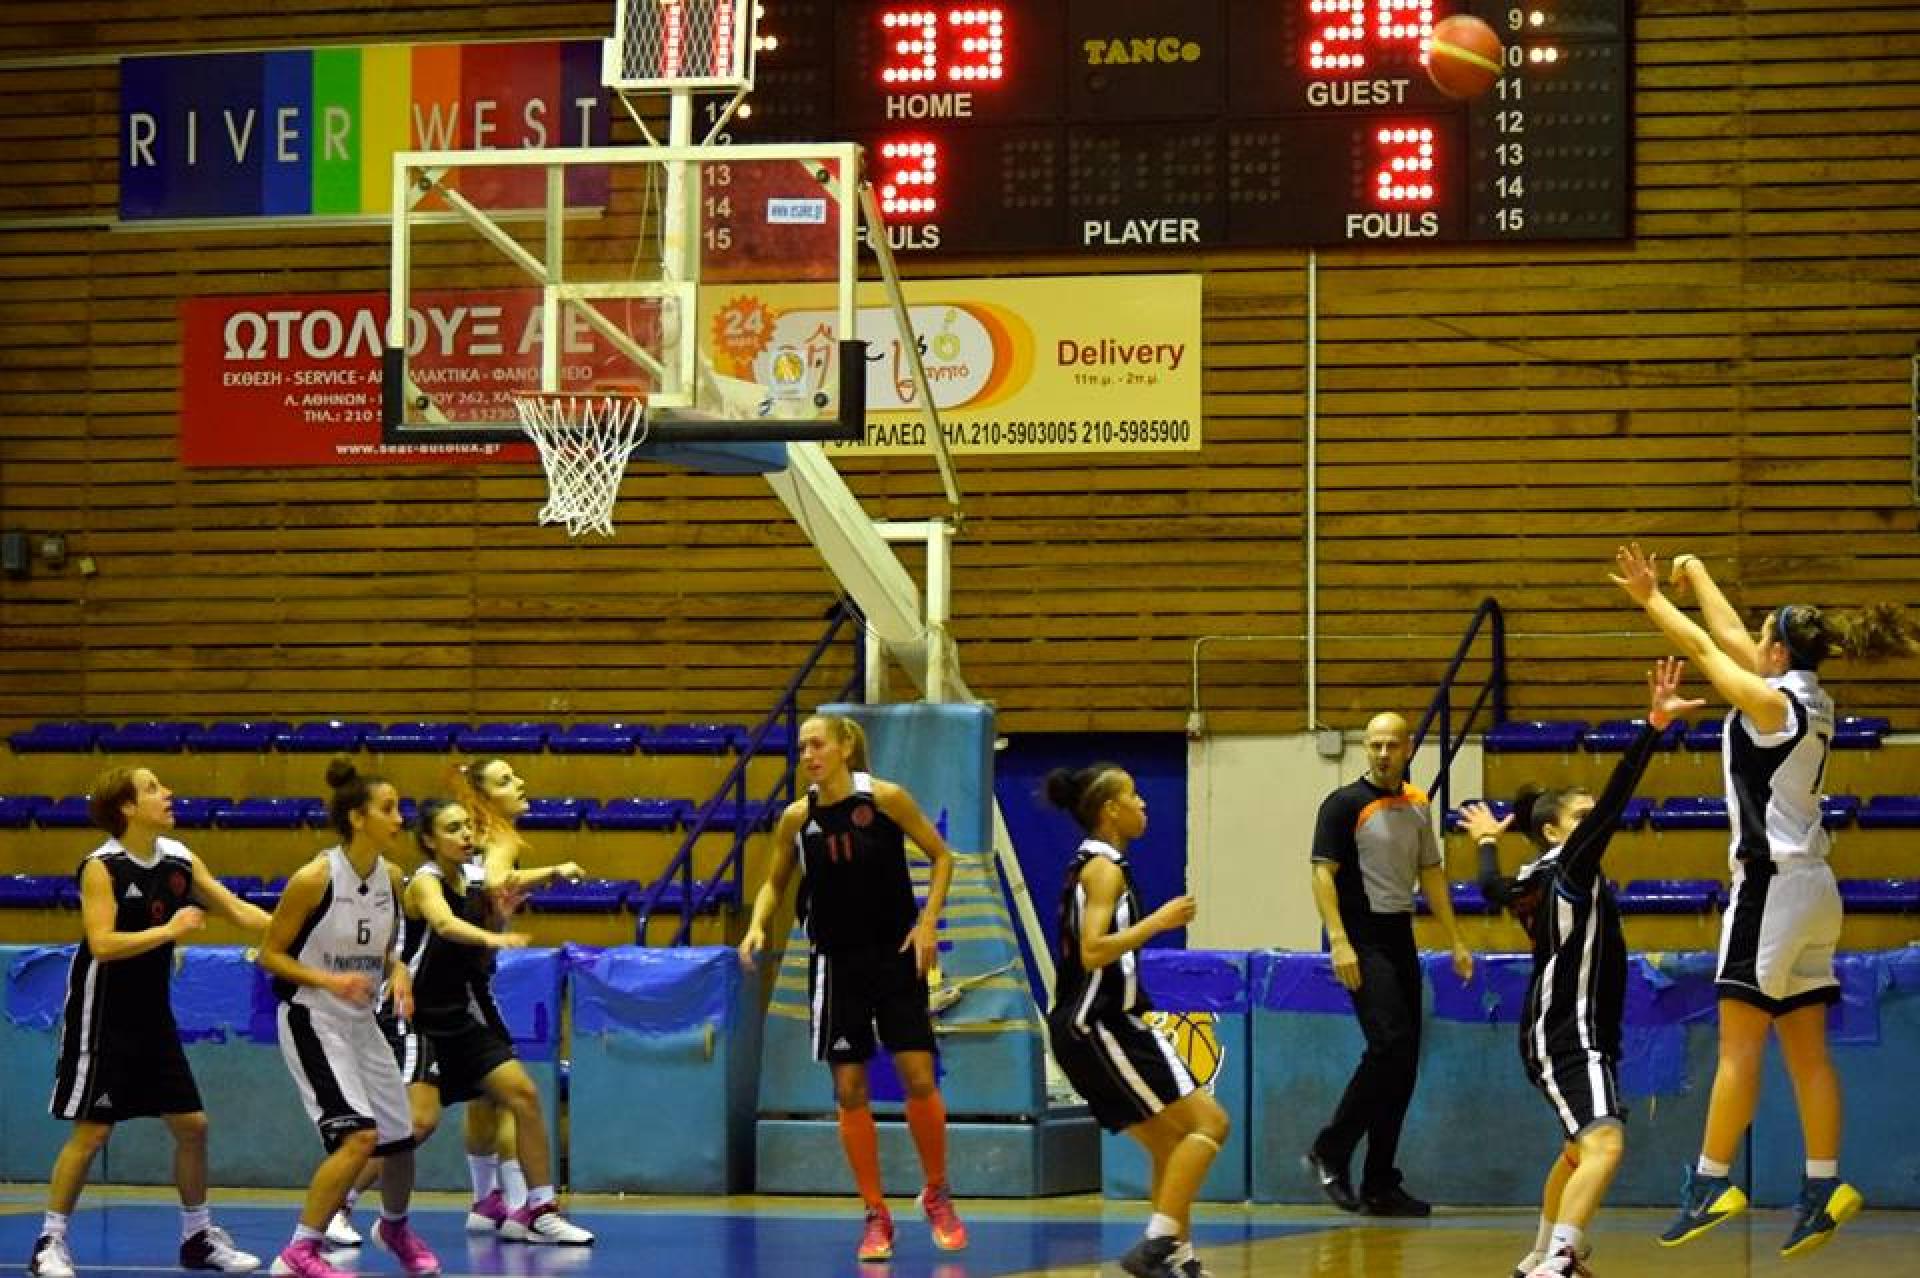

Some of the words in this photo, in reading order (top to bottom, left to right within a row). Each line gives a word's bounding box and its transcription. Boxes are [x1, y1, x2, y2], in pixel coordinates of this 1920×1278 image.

[1507, 8, 1524, 31] 9
[882, 8, 1003, 82] 33
[1307, 79, 1411, 107] GUEST
[1495, 77, 1522, 101] 11
[886, 93, 973, 119] HOME
[129, 106, 352, 168] RIVER
[413, 96, 597, 151] WEST
[1495, 112, 1524, 134] 12
[1377, 128, 1433, 200] 2
[1495, 144, 1524, 166] 13
[704, 164, 731, 186] 13
[881, 142, 937, 213] 2
[1495, 176, 1524, 199] 14
[704, 196, 731, 218] 14
[1495, 209, 1524, 231] 15
[704, 227, 731, 250] 15
[1084, 218, 1200, 245] PLAYER
[1346, 213, 1439, 239] FOULS
[1057, 339, 1185, 371] Delivery
[293, 369, 358, 385] SERVICE
[941, 420, 1078, 446] ΗΛ.210-5903005
[1081, 419, 1191, 443] 210-5985900
[1809, 731, 1829, 795] 7
[827, 833, 853, 865] 11
[357, 918, 371, 946] 6
